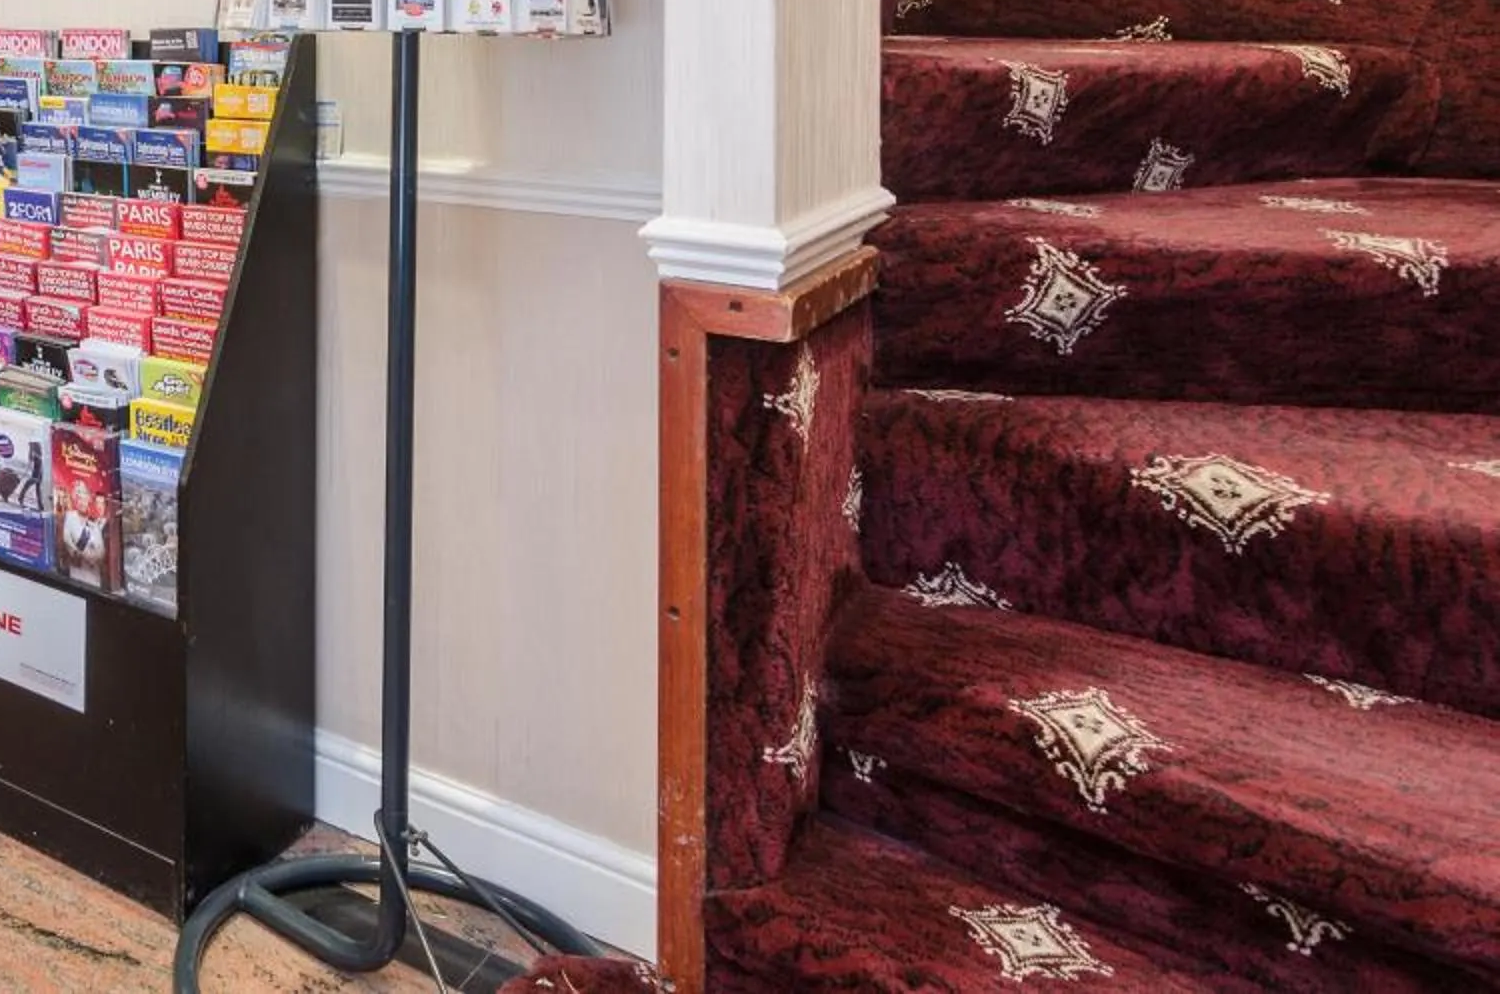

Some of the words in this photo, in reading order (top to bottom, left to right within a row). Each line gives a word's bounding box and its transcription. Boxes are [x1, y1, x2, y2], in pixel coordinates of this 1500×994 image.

[62, 34, 122, 51] LONDON
[8, 202, 52, 222] 2FOR1
[117, 203, 172, 226] PARIS
[109, 239, 164, 263] PARIS
